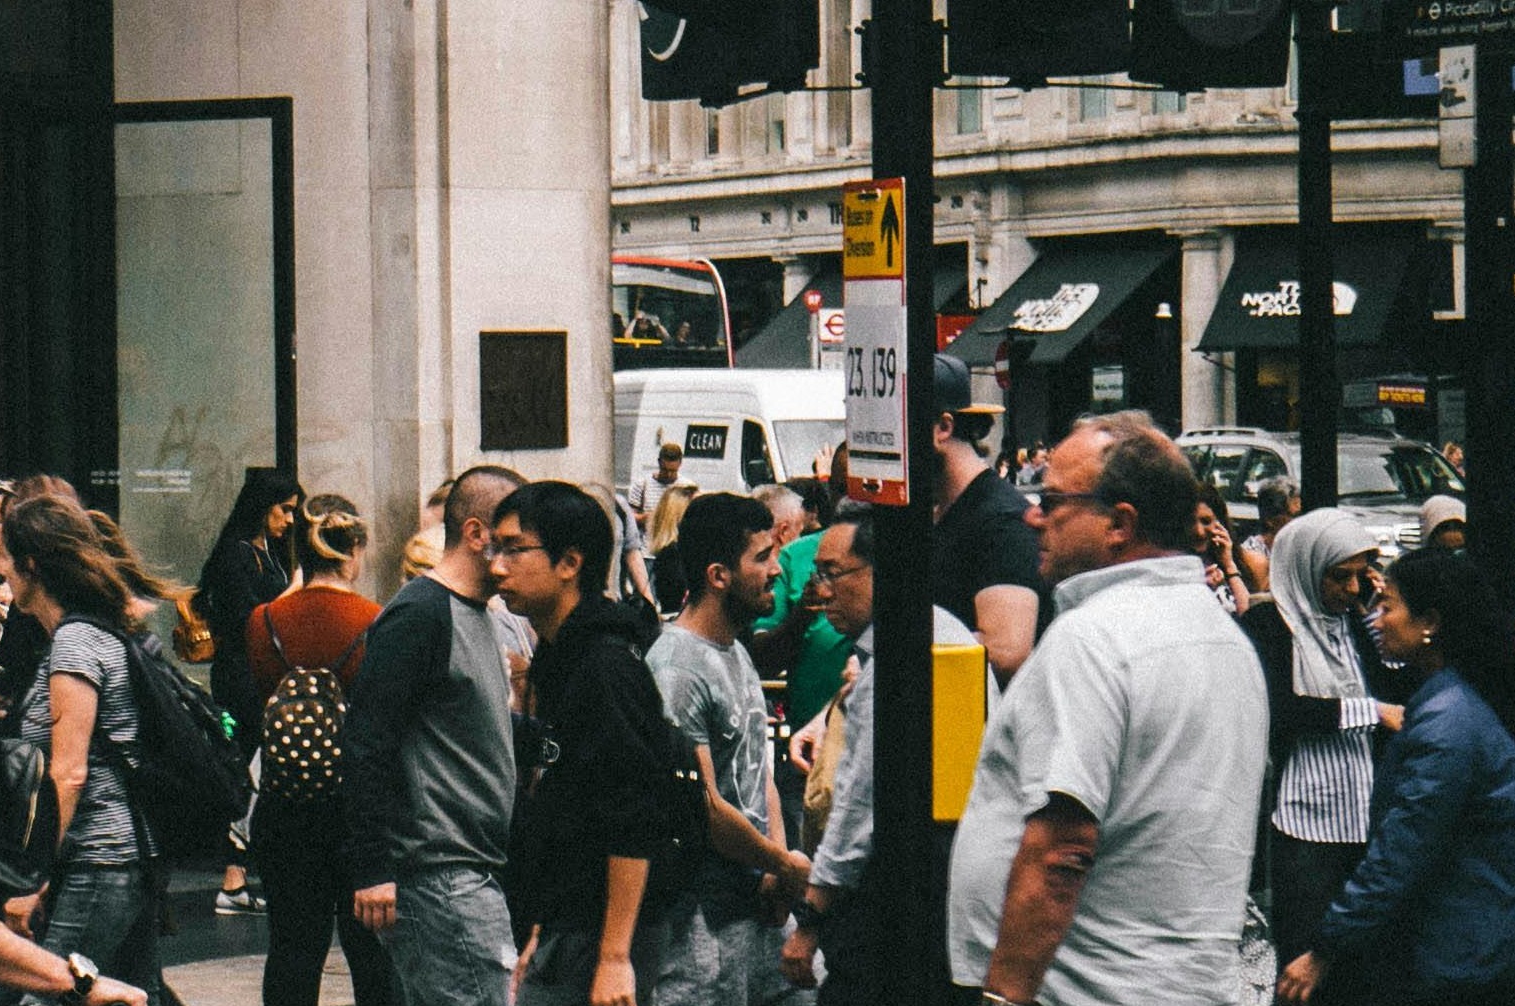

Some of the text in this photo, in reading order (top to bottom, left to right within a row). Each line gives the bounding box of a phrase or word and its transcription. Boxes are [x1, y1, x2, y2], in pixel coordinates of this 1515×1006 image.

[1242, 293, 1300, 306] NORT
[1257, 304, 1301, 316] FAC
[848, 347, 896, 398] 23, 139
[690, 432, 722, 450] CLEAN
